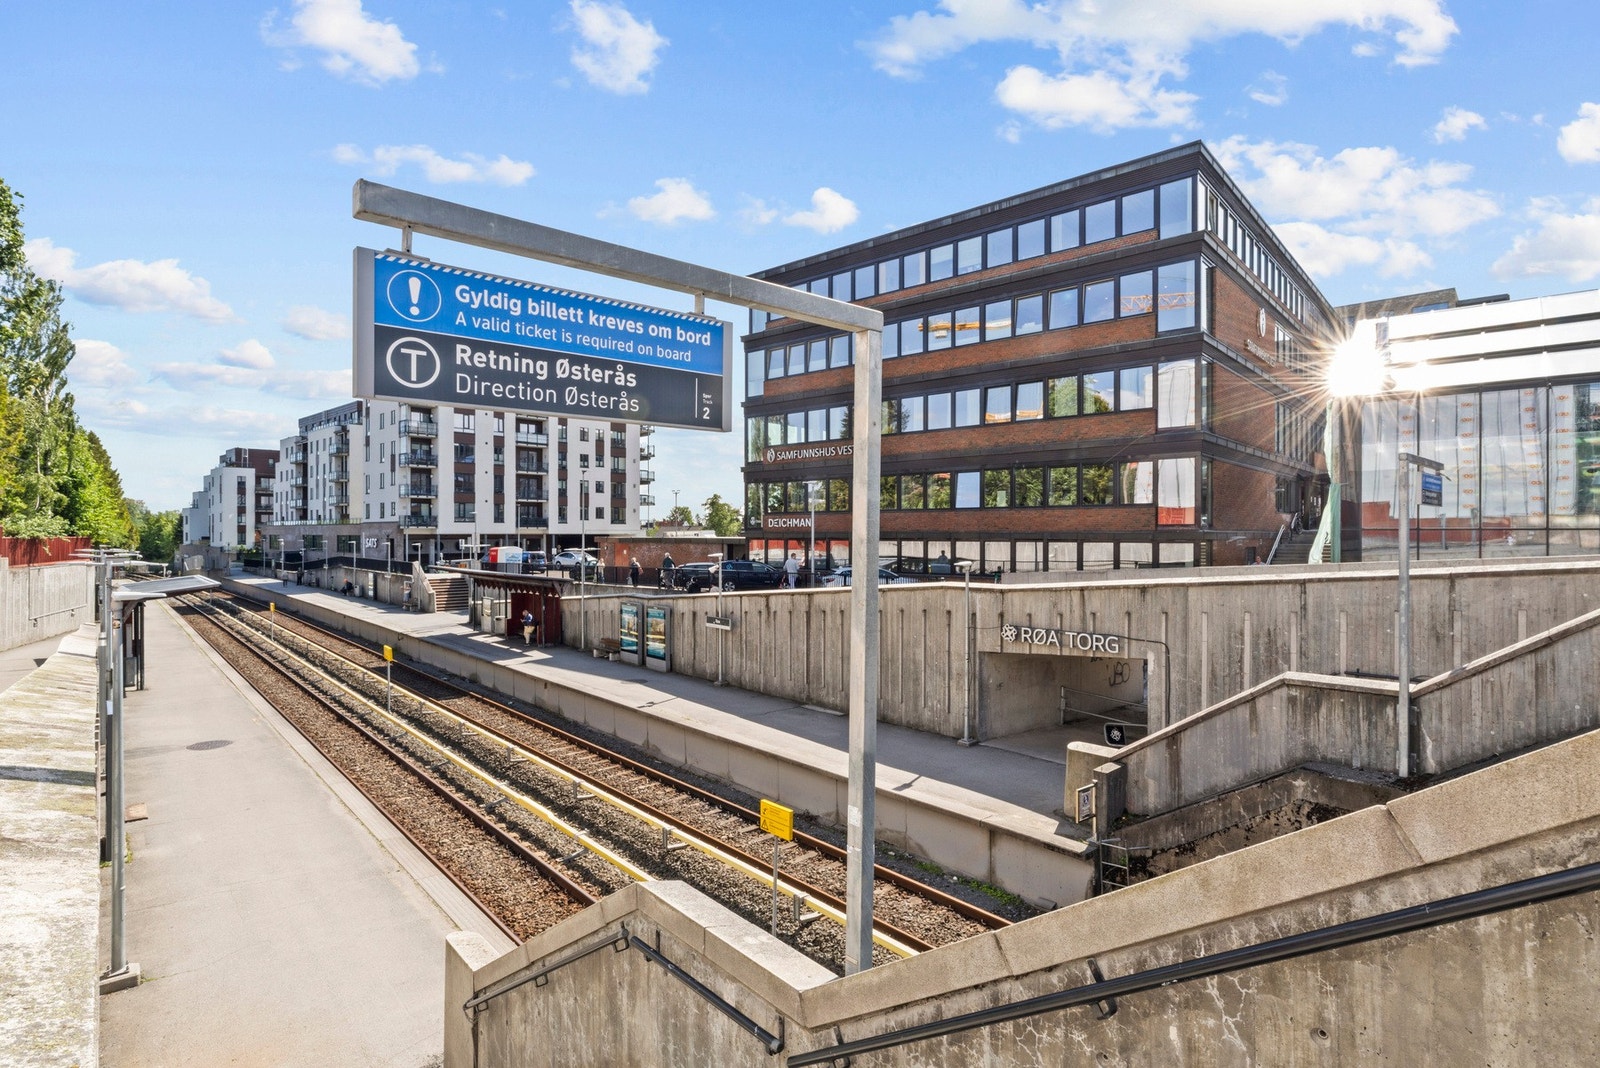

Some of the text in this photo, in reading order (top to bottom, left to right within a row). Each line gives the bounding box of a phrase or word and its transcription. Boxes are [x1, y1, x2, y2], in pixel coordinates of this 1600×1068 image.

[455, 284, 711, 346] Gyldig billett kreves om bord
[455, 311, 692, 362] A valid ticket is required on board
[456, 344, 637, 387] Retning Østerås
[456, 373, 640, 412] Direction Østerås
[702, 406, 710, 419] 2
[776, 446, 835, 461] SAMFUNNSHUS
[768, 518, 812, 528] DEICHMAN
[365, 538, 378, 548] SATS
[1020, 627, 1119, 654] RØA TORG
